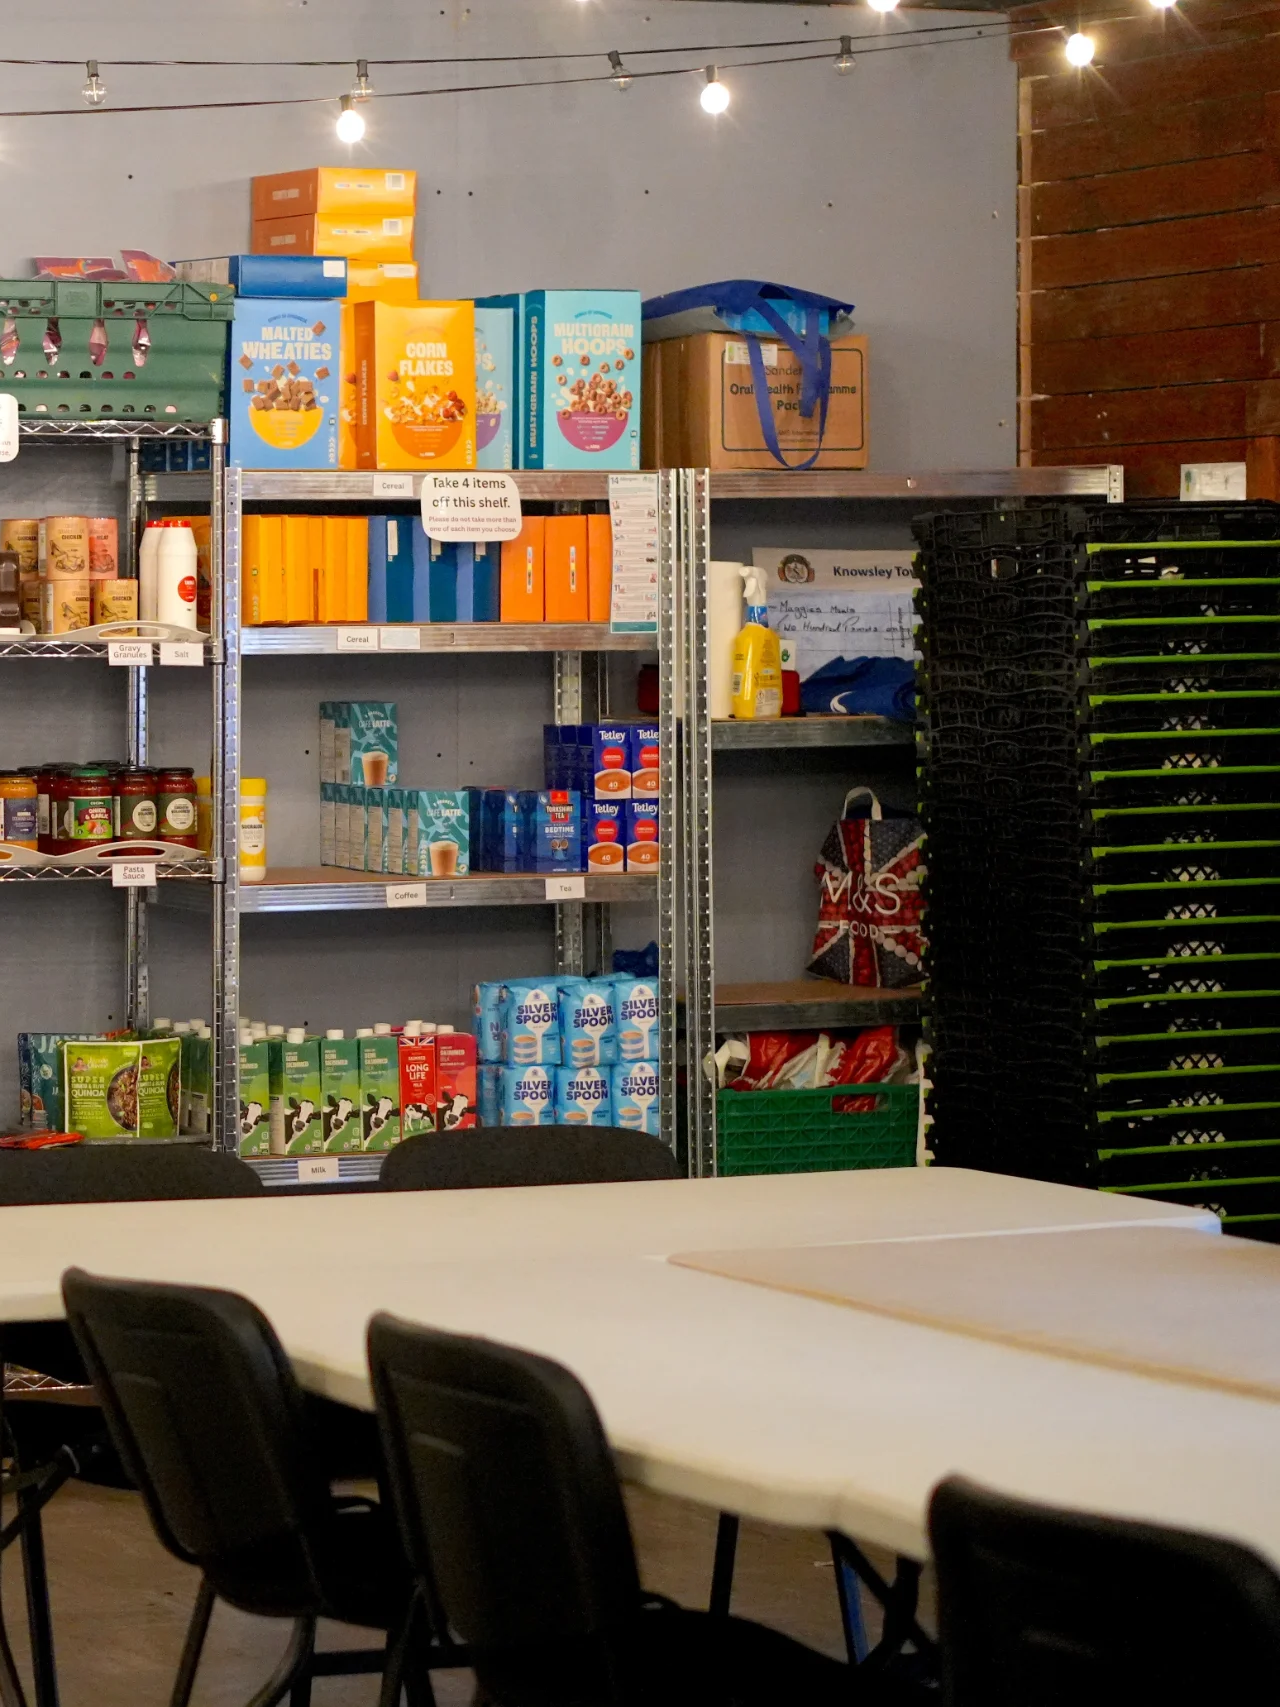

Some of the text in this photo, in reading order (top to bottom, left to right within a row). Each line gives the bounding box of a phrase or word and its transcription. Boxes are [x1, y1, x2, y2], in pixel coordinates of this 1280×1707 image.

[262, 326, 313, 341] MALTED
[554, 323, 634, 338] MULTIGRAIN
[242, 342, 332, 360] WHEATIES
[406, 342, 448, 358] CORN
[561, 338, 627, 356] HOOPS
[399, 360, 454, 376] FLAKES
[730, 383, 794, 395] Oral ealth
[530, 371, 538, 448] MULTIGRAIN
[432, 478, 506, 488] Take 4 items
[610, 476, 618, 484] 14
[432, 496, 510, 508] off this shelf.
[833, 566, 892, 579] Knowsley
[803, 618, 840, 632] Hundred
[346, 634, 369, 644] Cereal
[114, 650, 148, 658] Granules
[372, 720, 390, 728] LATTE
[599, 730, 625, 743] Tetley
[441, 808, 461, 816] LATTE
[593, 803, 618, 816] Tetley
[632, 802, 658, 816] Tetley
[394, 892, 418, 900] Coffee
[820, 870, 900, 915] M&S
[840, 920, 878, 938] FOOD
[517, 1002, 557, 1014] SILVER
[574, 1005, 613, 1018] SILVER
[516, 1013, 558, 1024] SPOON
[573, 1016, 613, 1028] SPOON
[406, 1064, 429, 1073] LONG
[409, 1072, 426, 1080] LIFE
[516, 1080, 551, 1090] SILVER
[568, 1080, 607, 1090] SILVER
[138, 1087, 165, 1096] QUINOA
[514, 1090, 552, 1100] SPOON
[566, 1089, 608, 1100] SPOON
[310, 1166, 326, 1174] Milk
